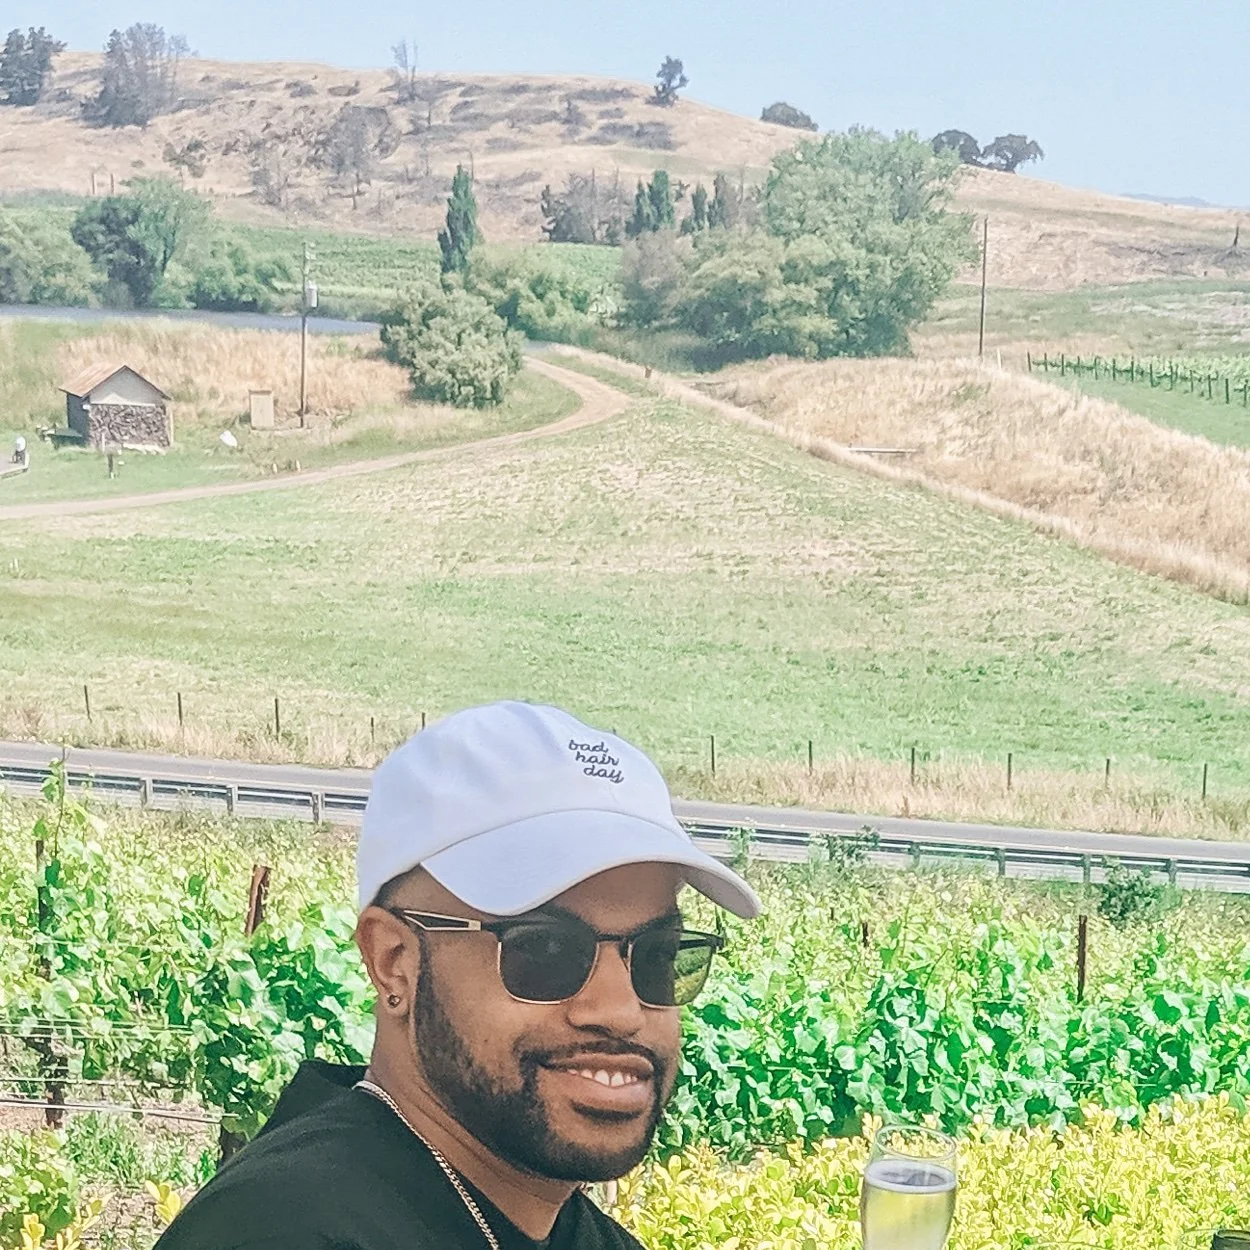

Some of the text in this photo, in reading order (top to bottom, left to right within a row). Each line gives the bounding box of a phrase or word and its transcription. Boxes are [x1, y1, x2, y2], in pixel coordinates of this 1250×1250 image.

[568, 740, 609, 753] bad
[575, 751, 620, 766] hair
[583, 765, 624, 784] day
